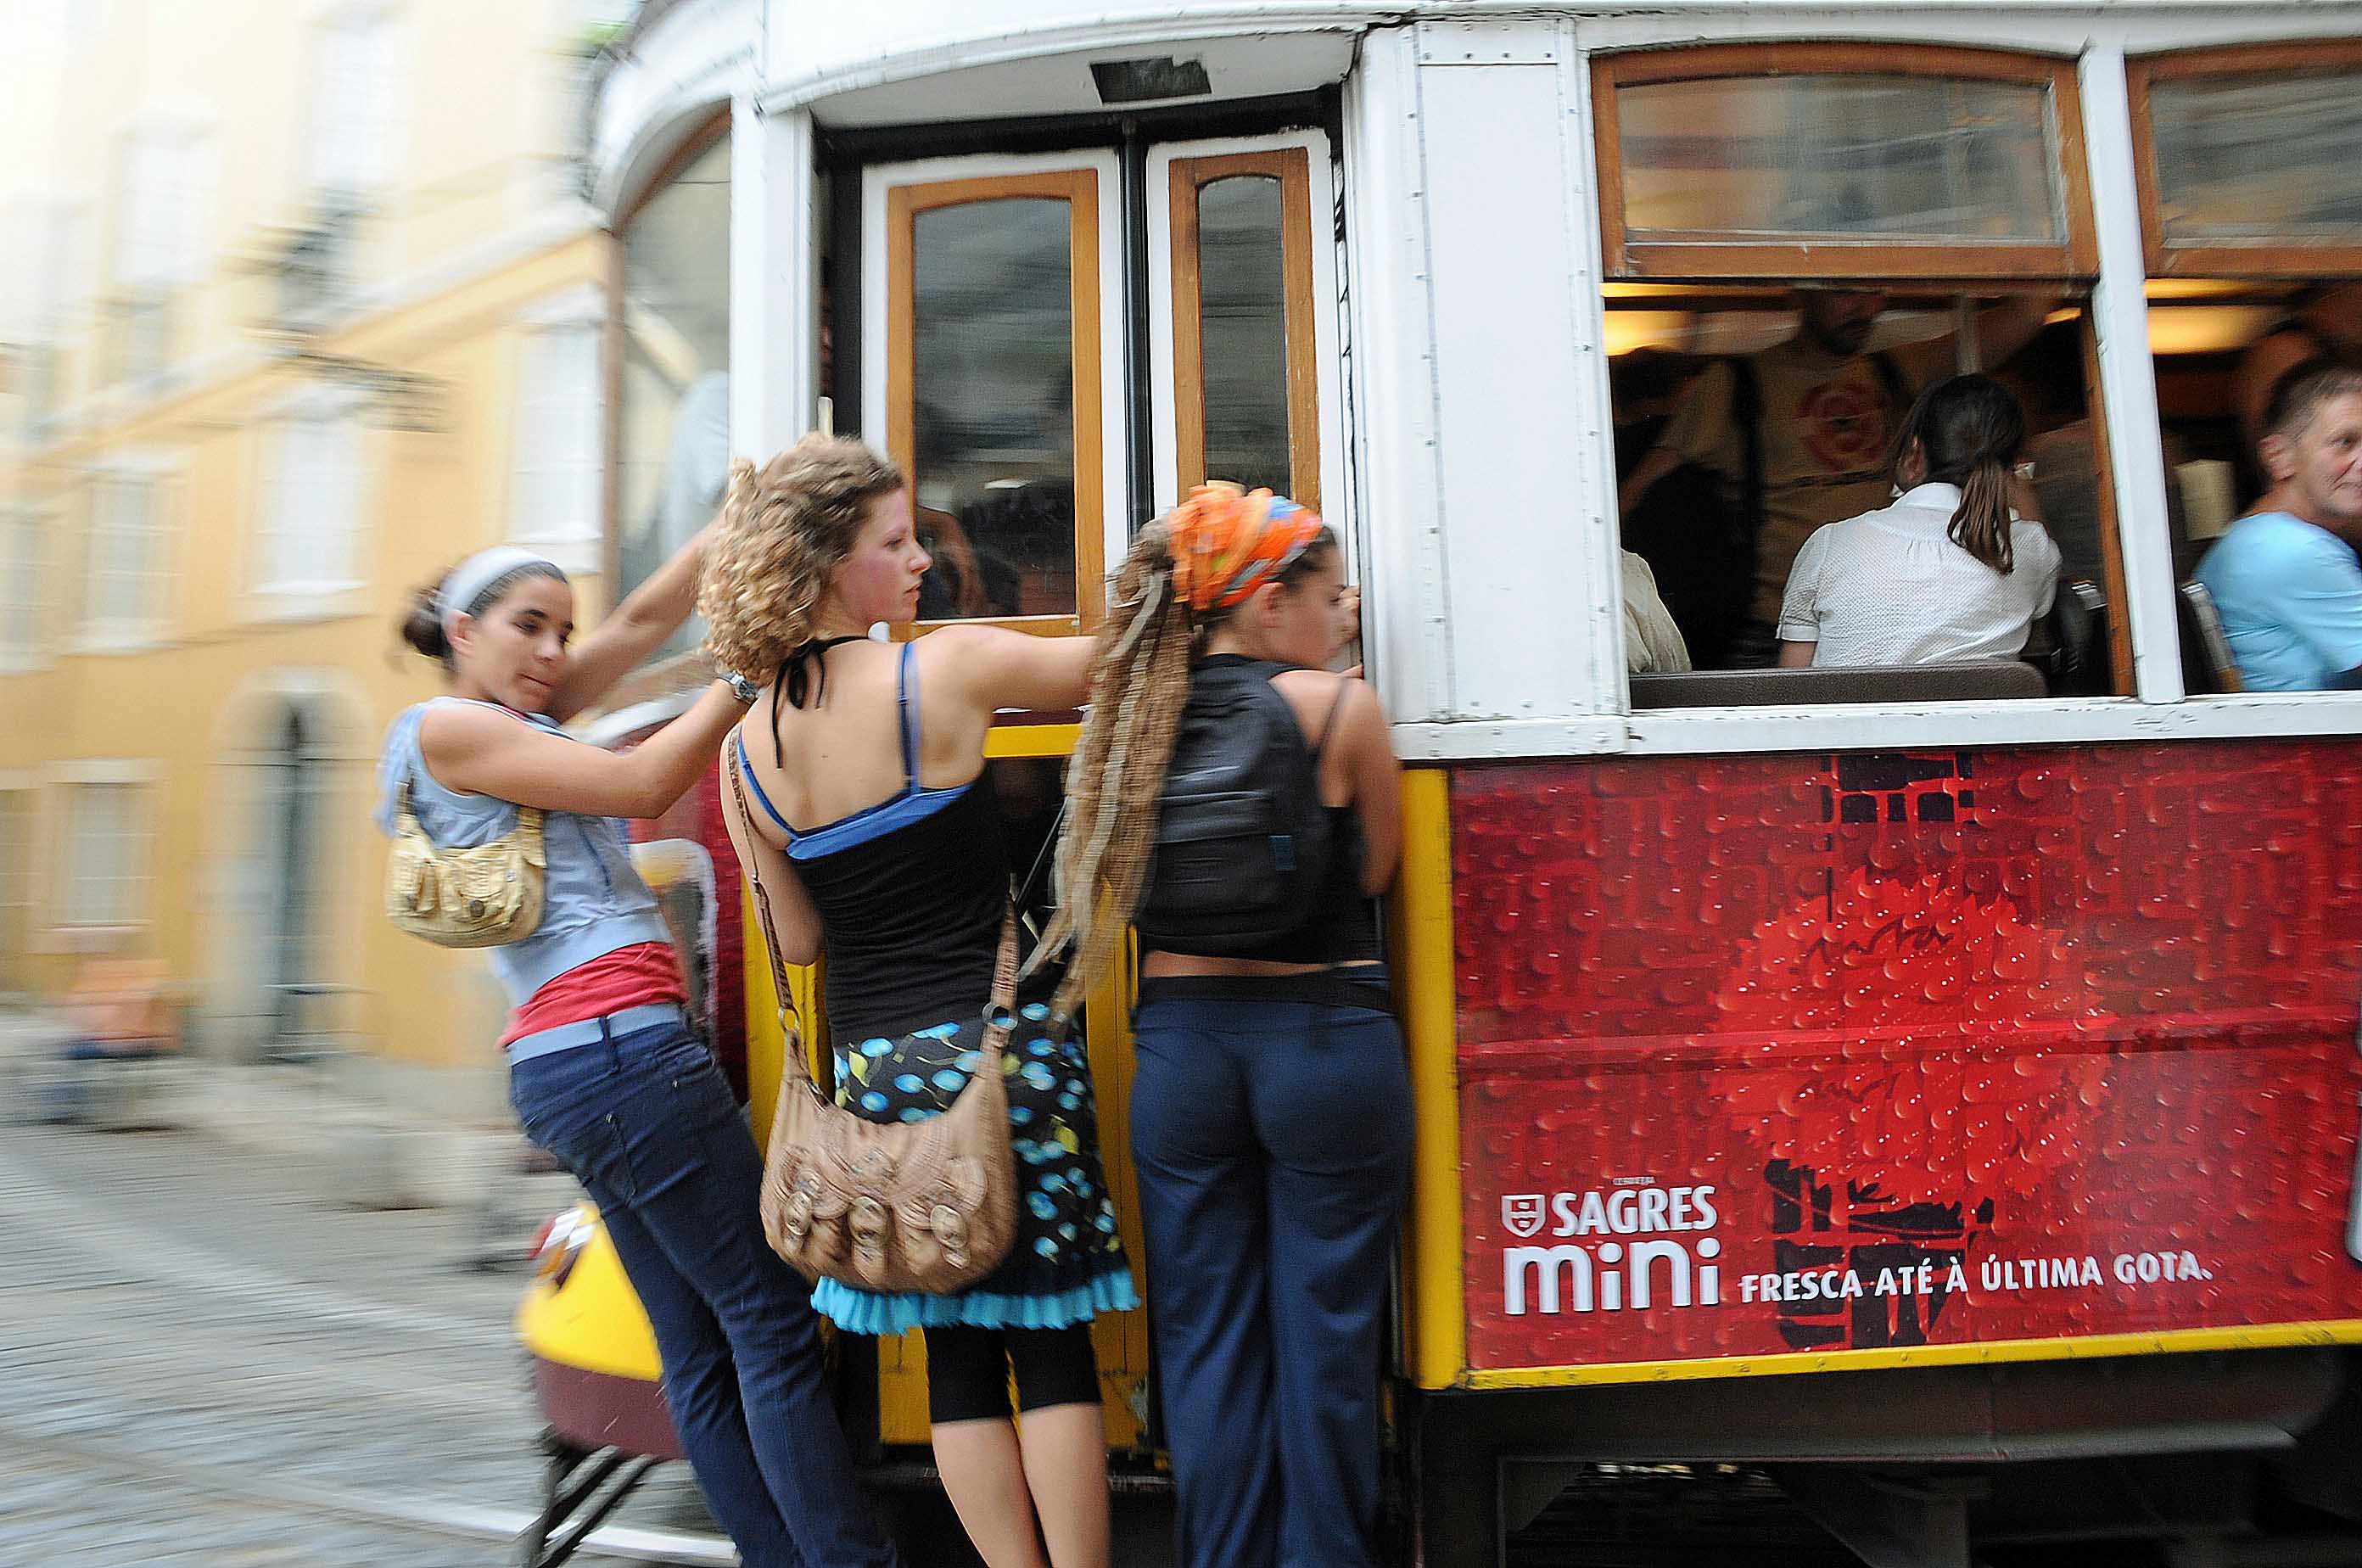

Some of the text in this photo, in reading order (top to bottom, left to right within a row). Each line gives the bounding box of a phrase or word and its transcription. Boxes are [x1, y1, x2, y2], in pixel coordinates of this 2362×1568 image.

[1552, 1186, 1718, 1237] SAGRES
[1503, 1237, 1721, 1315] mini
[1741, 1250, 2214, 1302] FRESCA ATÉ À ÚLTIMA GOTA.
